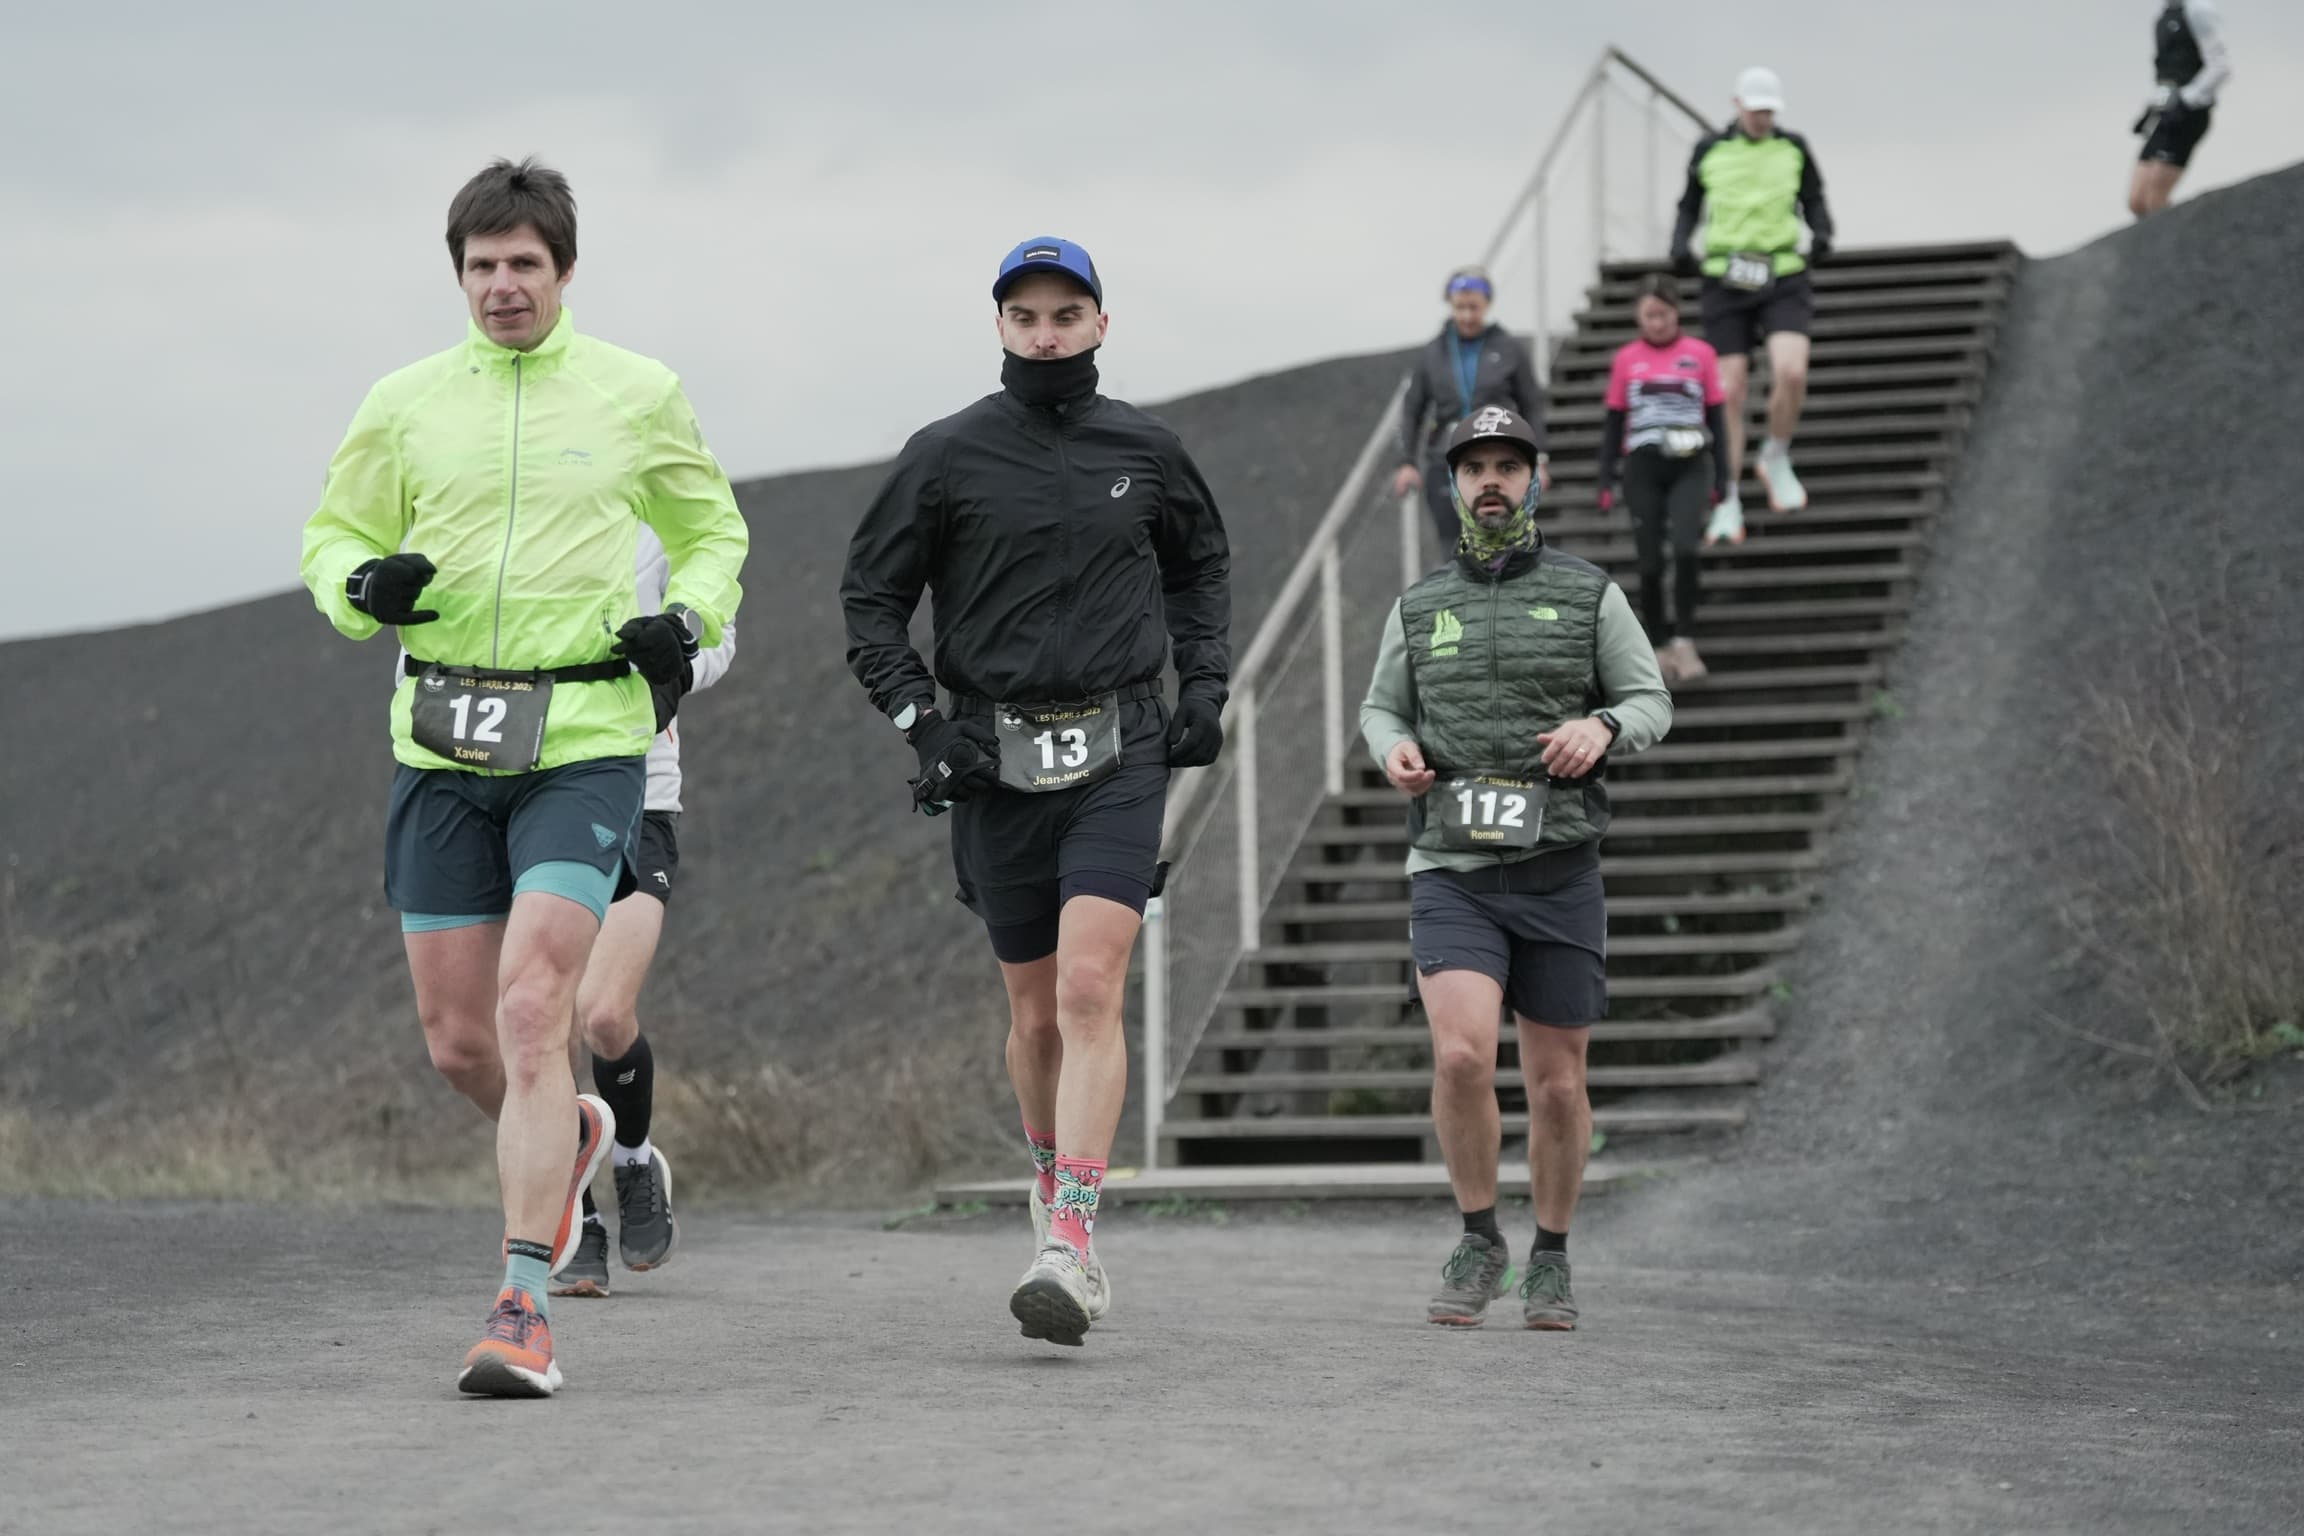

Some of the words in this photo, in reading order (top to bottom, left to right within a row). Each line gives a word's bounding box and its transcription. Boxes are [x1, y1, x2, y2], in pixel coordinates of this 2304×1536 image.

[460, 677, 476, 688] LES
[449, 693, 507, 743] 12
[454, 745, 491, 761] Xavier
[1033, 728, 1088, 769] 13
[1033, 769, 1090, 786] Jean-Marc
[1457, 788, 1527, 828] 112
[1471, 830, 1505, 840] Romain
[1061, 1187, 1097, 1206] DBDB
